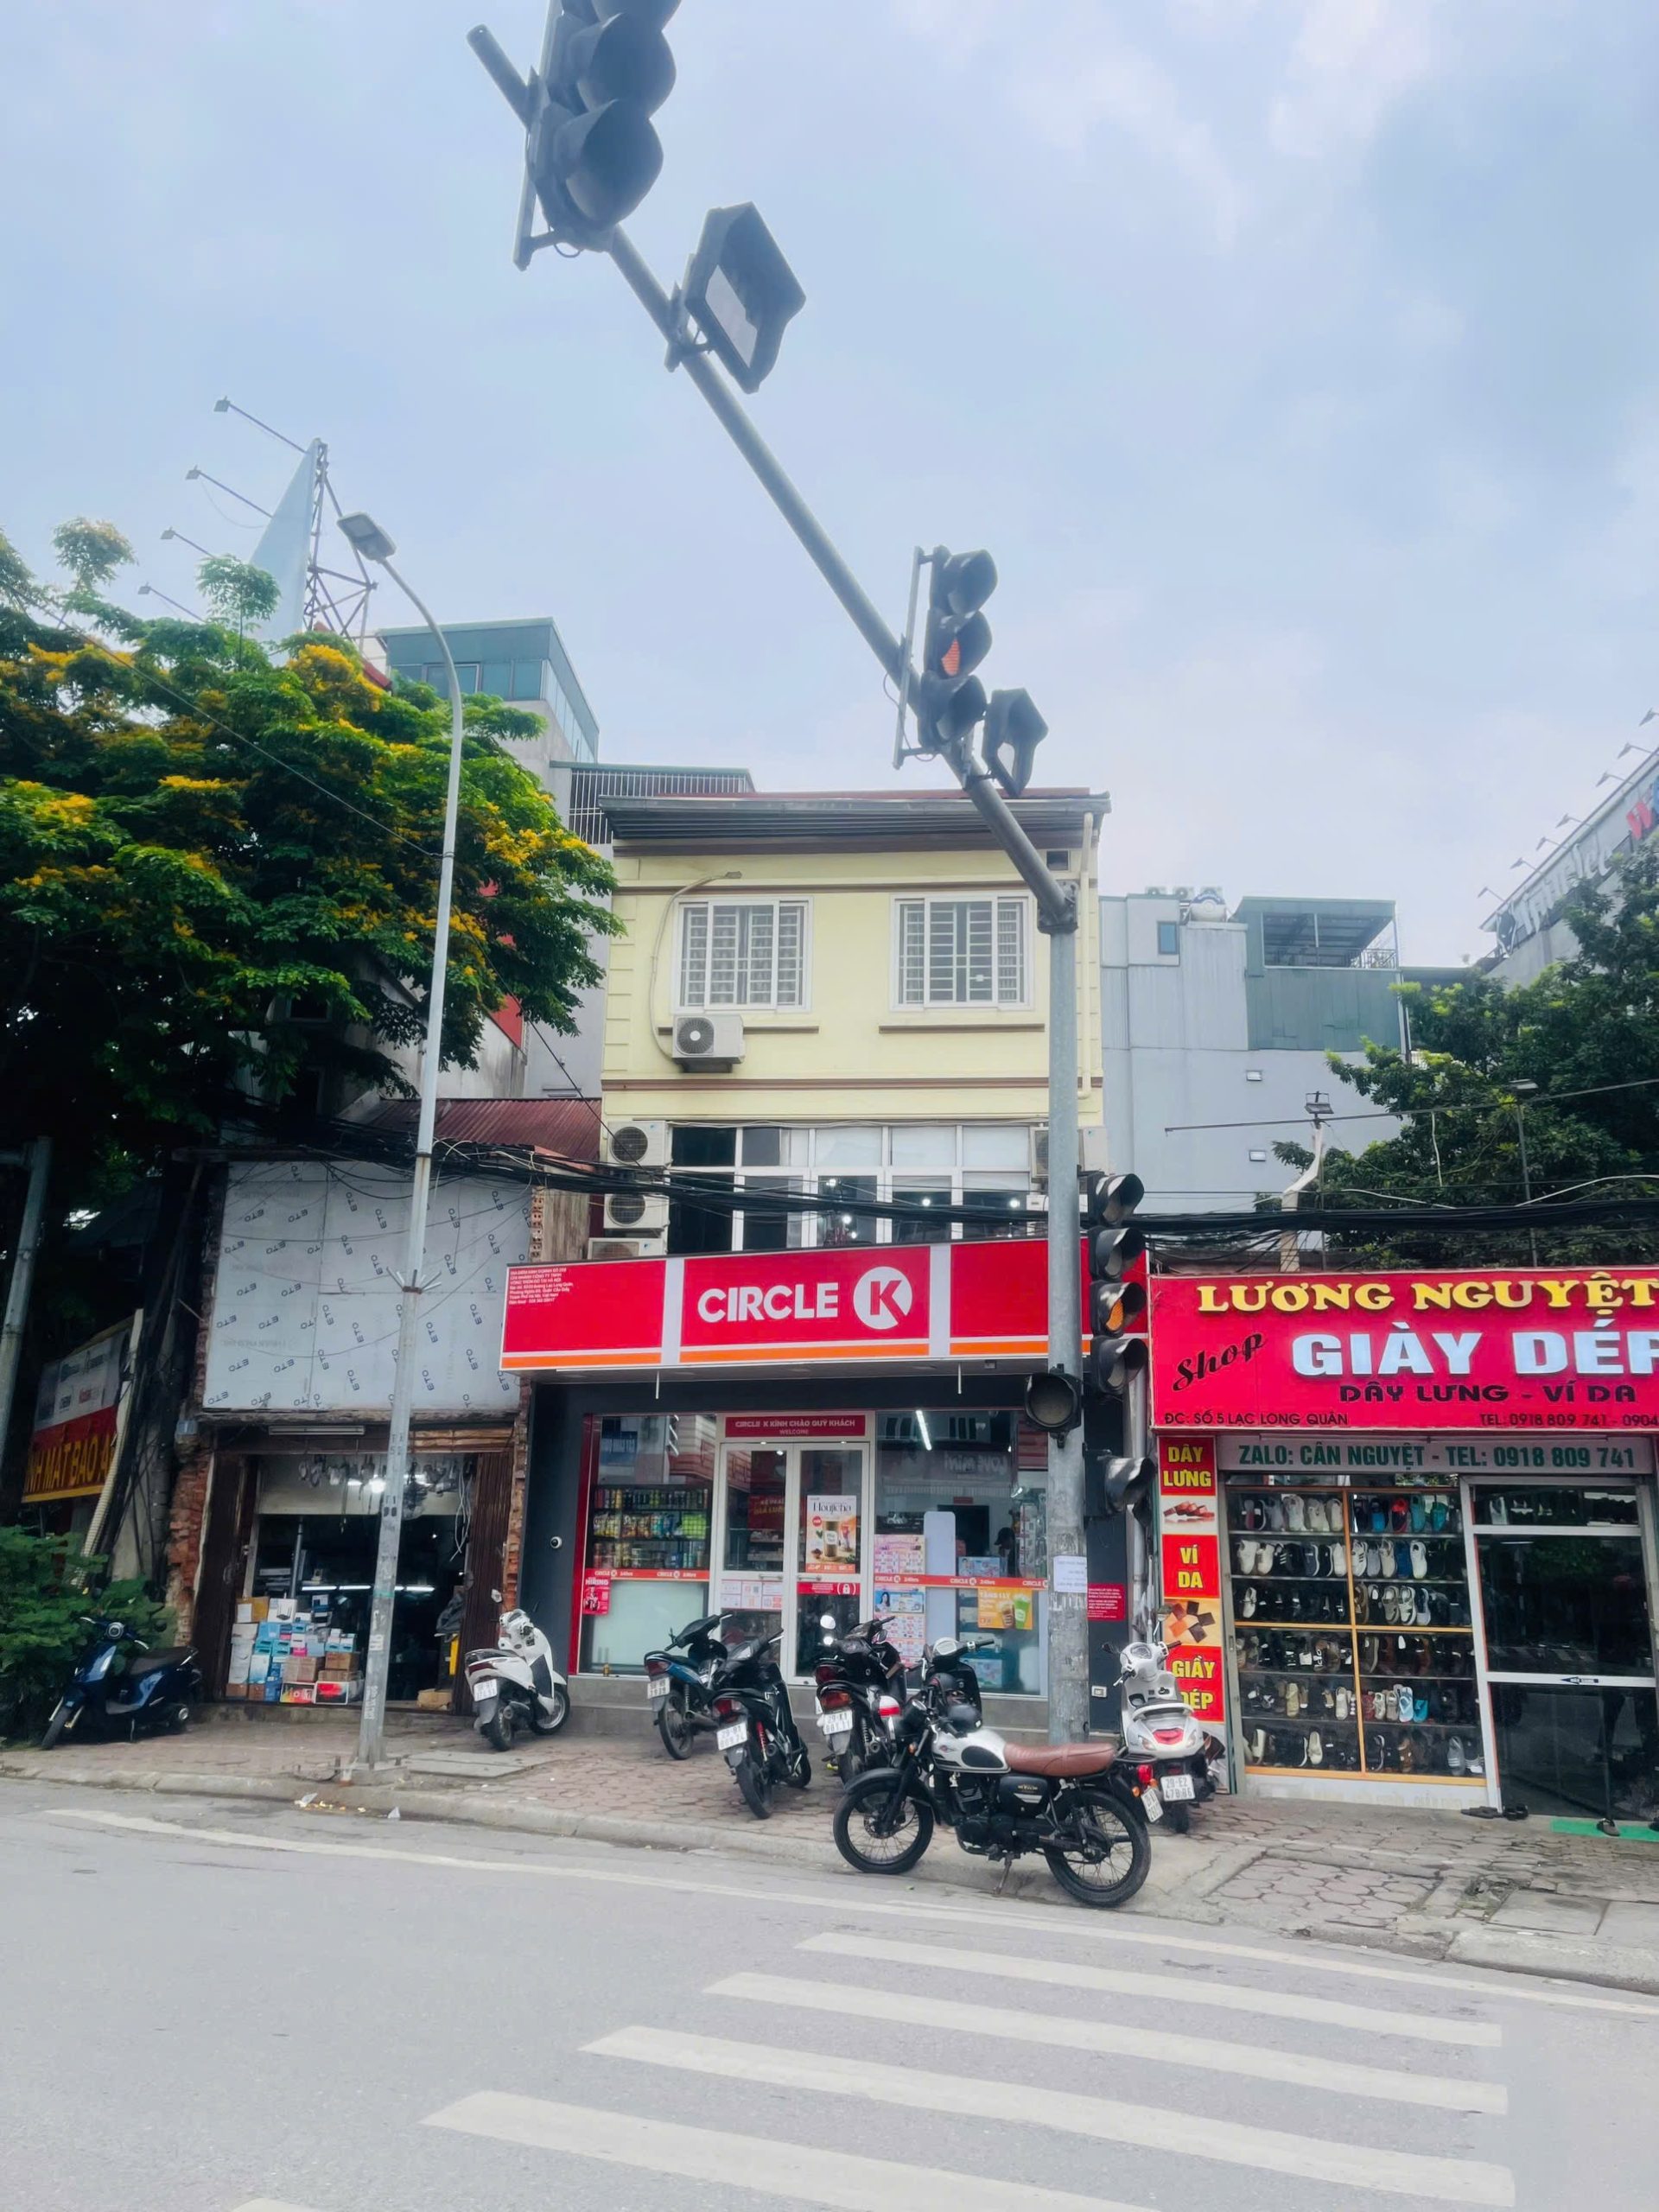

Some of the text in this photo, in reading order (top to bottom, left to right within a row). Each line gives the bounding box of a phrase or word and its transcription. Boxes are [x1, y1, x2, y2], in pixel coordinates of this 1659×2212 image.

[346, 1192, 357, 1211] ETO
[492, 1191, 504, 1211] ETO
[245, 1209, 264, 1223] ETO
[288, 1209, 308, 1223] ETO
[375, 1208, 387, 1229] ETO
[448, 1208, 460, 1228] ETO
[224, 1240, 245, 1254] ETO
[266, 1240, 286, 1255] ETO
[341, 1235, 353, 1255] ETO
[488, 1234, 500, 1254] ETO
[371, 1255, 383, 1275] ETO
[444, 1255, 456, 1274] ETO
[237, 1282, 257, 1296] ETO
[281, 1283, 302, 1296] ETO
[1197, 1271, 1659, 1315] LƯƠNG NGUYỆT
[697, 1273, 910, 1326] CIRCLE K
[217, 1314, 237, 1328] ETO
[258, 1315, 279, 1329] ETO
[322, 1305, 334, 1325] ETO
[470, 1304, 482, 1325] ETO
[353, 1322, 364, 1343] ETO
[426, 1322, 438, 1343] ETO
[1293, 1322, 1483, 1376] GIÀY
[228, 1358, 249, 1372] ETO
[274, 1358, 295, 1373] ETO
[318, 1349, 329, 1370] ETO
[466, 1349, 478, 1370] ETO
[1173, 1332, 1268, 1392] Shop
[347, 1370, 359, 1390] ETO
[422, 1370, 435, 1390] ETO
[497, 1370, 510, 1391] ETO
[207, 1391, 229, 1405] ETO
[251, 1392, 271, 1406] ETO
[1340, 1381, 1404, 1402] DÂY
[1417, 1384, 1509, 1402] LƯNG
[1542, 1380, 1577, 1402] VÍ
[1588, 1384, 1636, 1402] DA
[829, 1418, 855, 1427] KHÁCH
[1164, 1408, 1348, 1427] ĐC: SỐ 5 LẠC LONG QUÂN
[1510, 1413, 1542, 1426] 0918
[1548, 1413, 1576, 1426] 809
[1582, 1413, 1607, 1426] 741
[1168, 1444, 1204, 1463] DÂY
[1239, 1444, 1294, 1465] ZALO:
[1300, 1441, 1341, 1465] CÂN
[1347, 1442, 1425, 1470] NGUYỆT
[1446, 1446, 1487, 1466] TEL:
[1493, 1446, 1544, 1467] 0918
[1551, 1446, 1591, 1467] 809
[1597, 1447, 1634, 1467] 741
[1163, 1470, 1212, 1487] LƯNG
[1180, 1544, 1198, 1565] VÍ
[1178, 1571, 1204, 1589] DA
